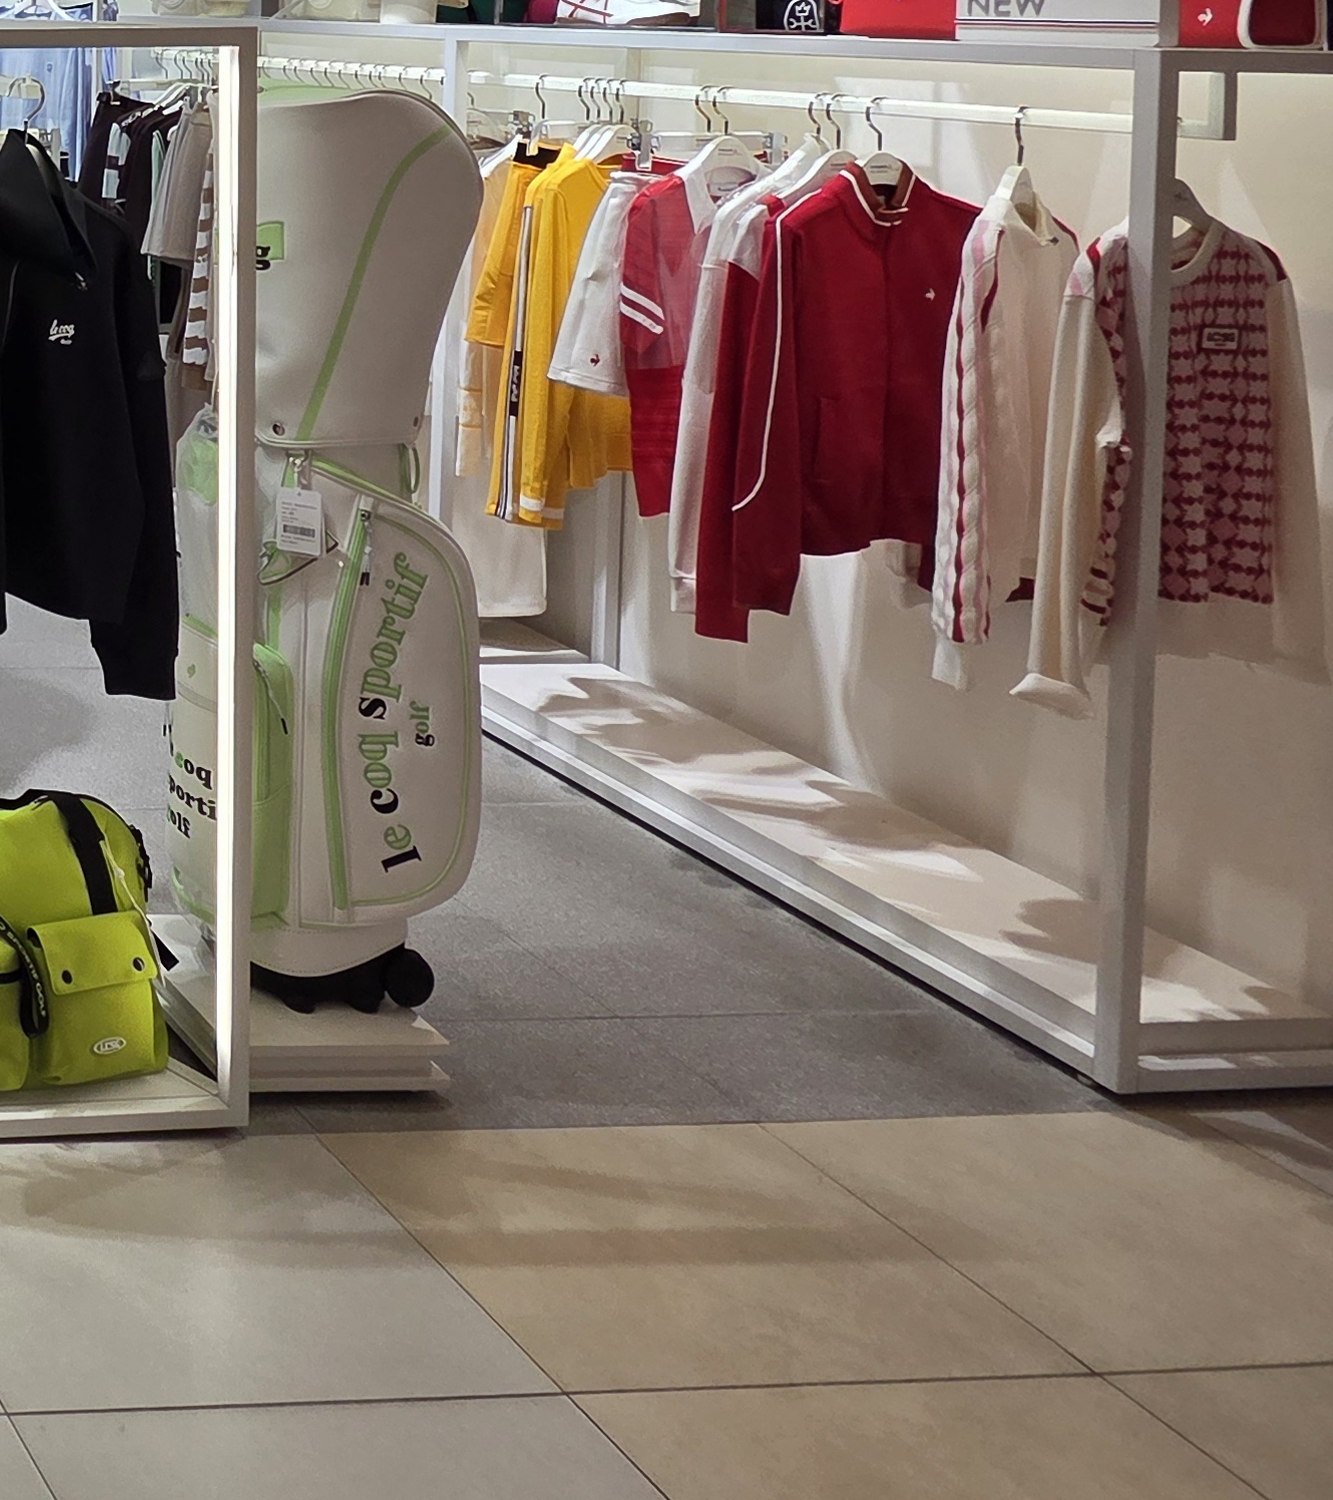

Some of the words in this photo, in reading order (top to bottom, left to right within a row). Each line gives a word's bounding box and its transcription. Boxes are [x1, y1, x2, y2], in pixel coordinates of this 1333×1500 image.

[359, 552, 429, 721] sportif
[409, 700, 436, 748] golf
[358, 730, 400, 815] coq
[381, 824, 422, 874] le
